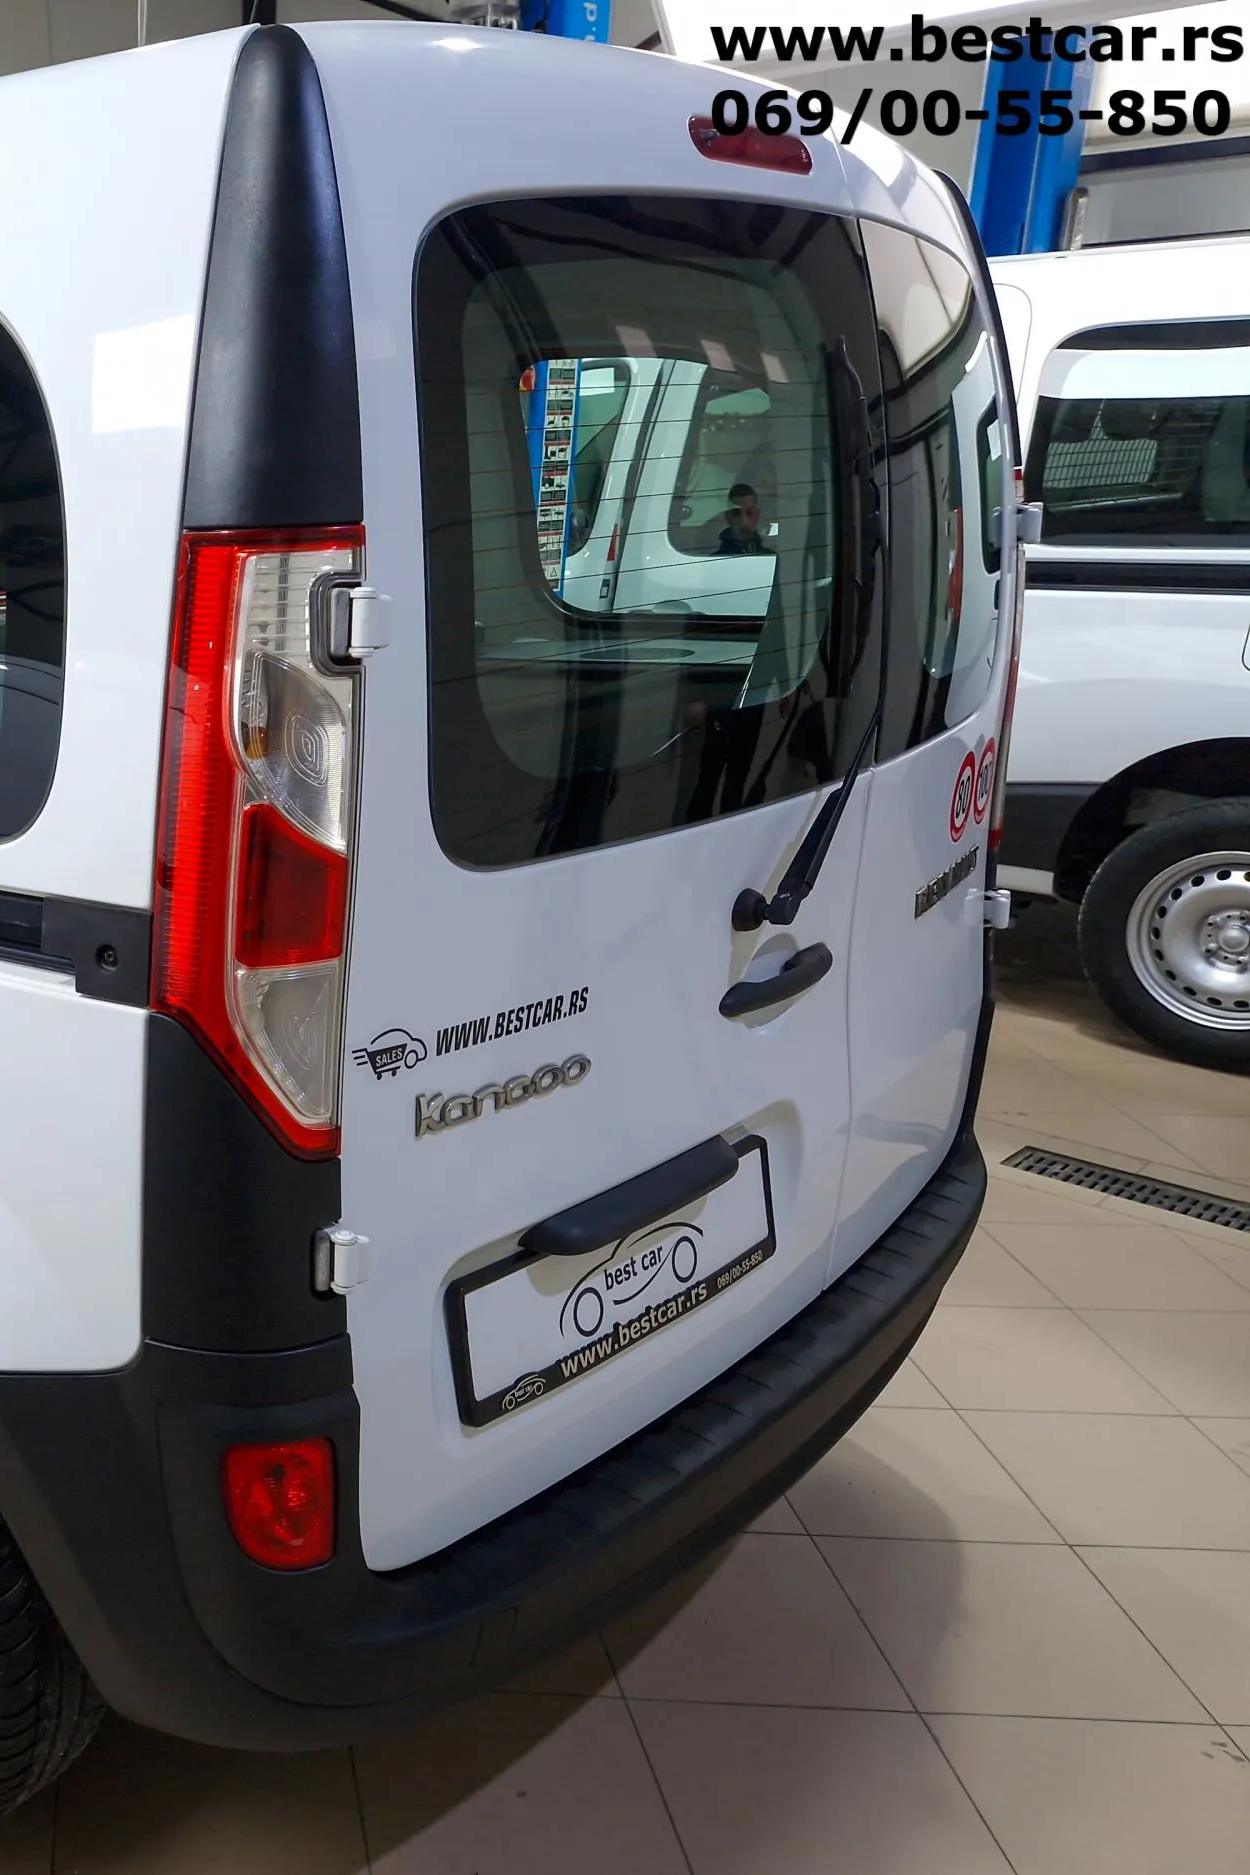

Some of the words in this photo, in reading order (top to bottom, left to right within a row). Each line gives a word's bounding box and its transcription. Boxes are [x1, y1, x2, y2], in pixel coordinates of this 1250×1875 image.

[955, 774, 971, 820] 80
[436, 987, 589, 1056] WWW.BESTCAR.RS
[375, 1047, 403, 1067] SALES
[603, 1256, 638, 1291] best
[641, 1245, 663, 1271] car
[560, 1281, 708, 1379] www.bestcar.rs
